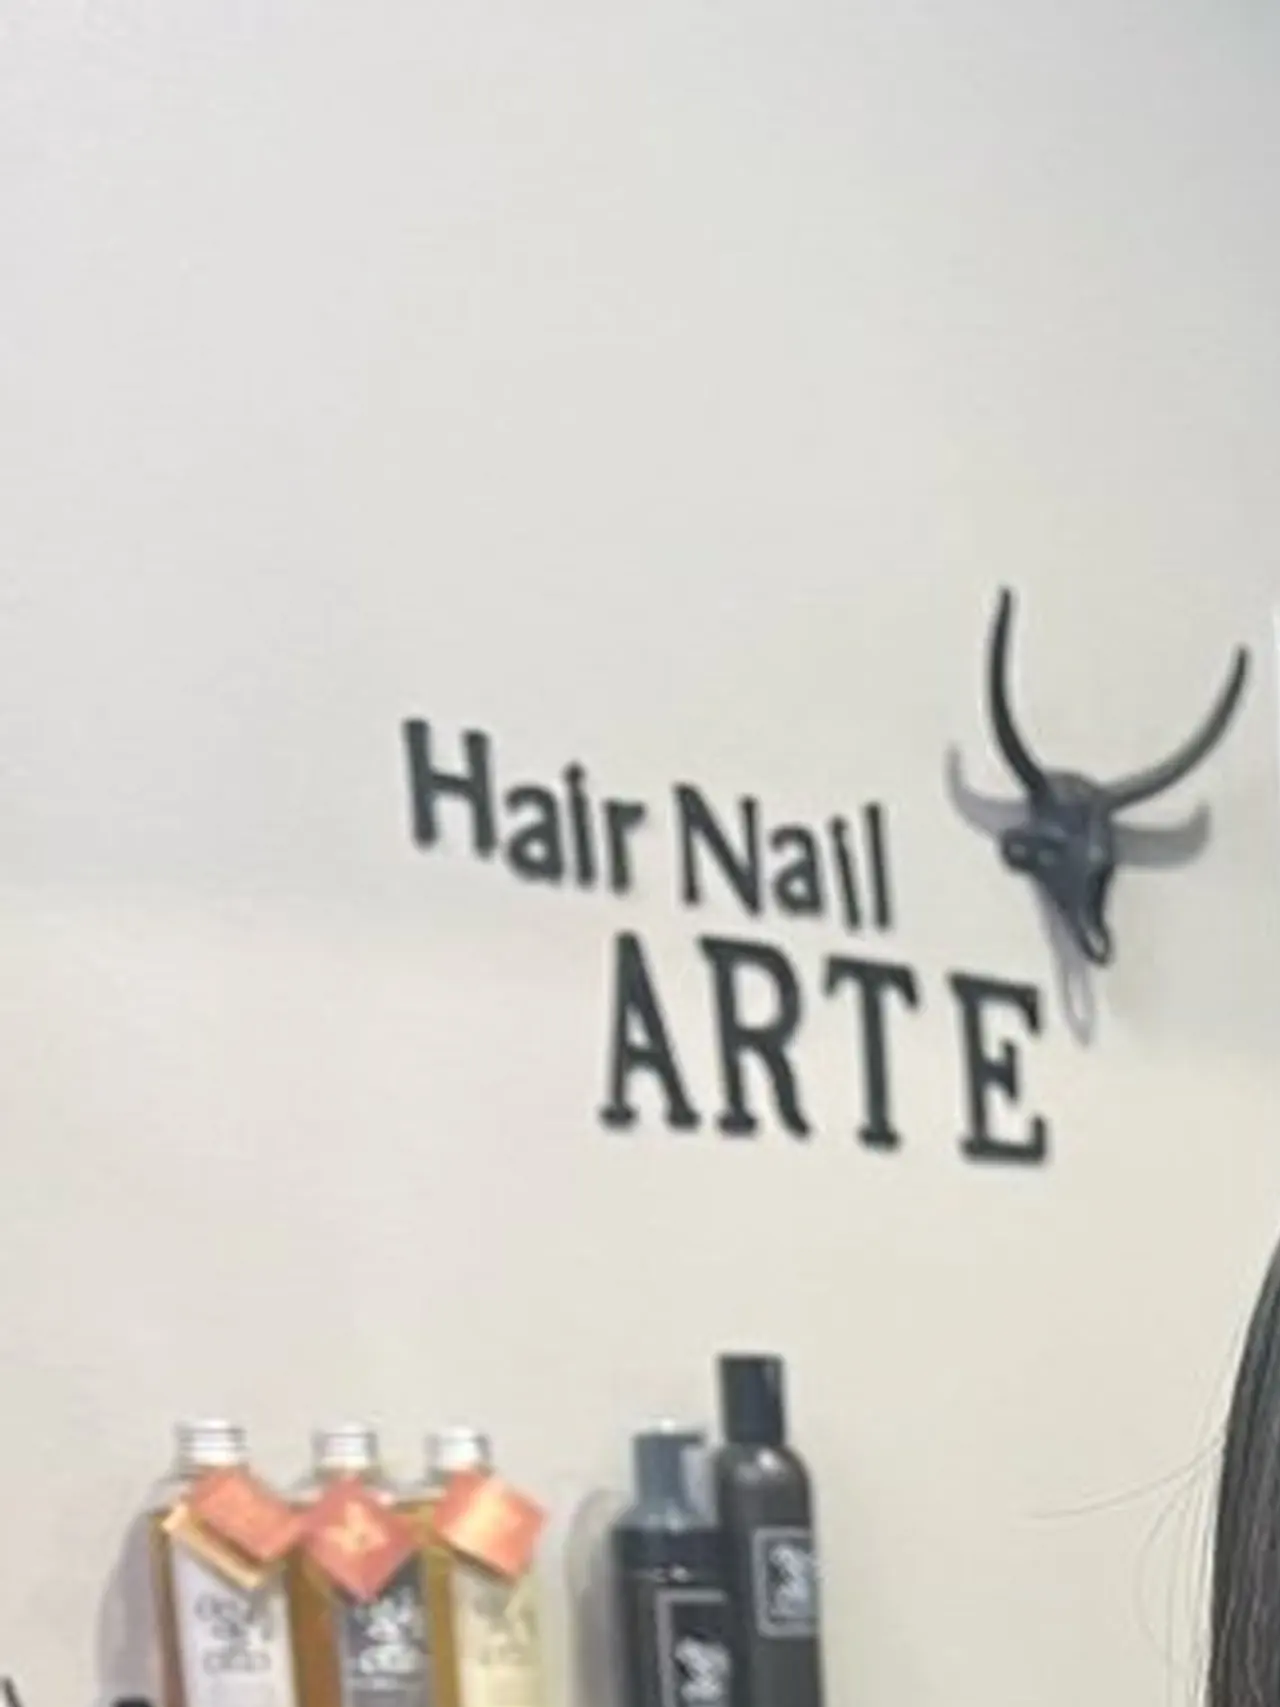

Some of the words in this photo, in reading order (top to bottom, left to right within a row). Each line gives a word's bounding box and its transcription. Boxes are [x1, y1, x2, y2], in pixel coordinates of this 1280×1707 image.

[403, 718, 647, 894] Hair
[673, 783, 892, 931] Nail
[600, 931, 1048, 1166] ARTE
